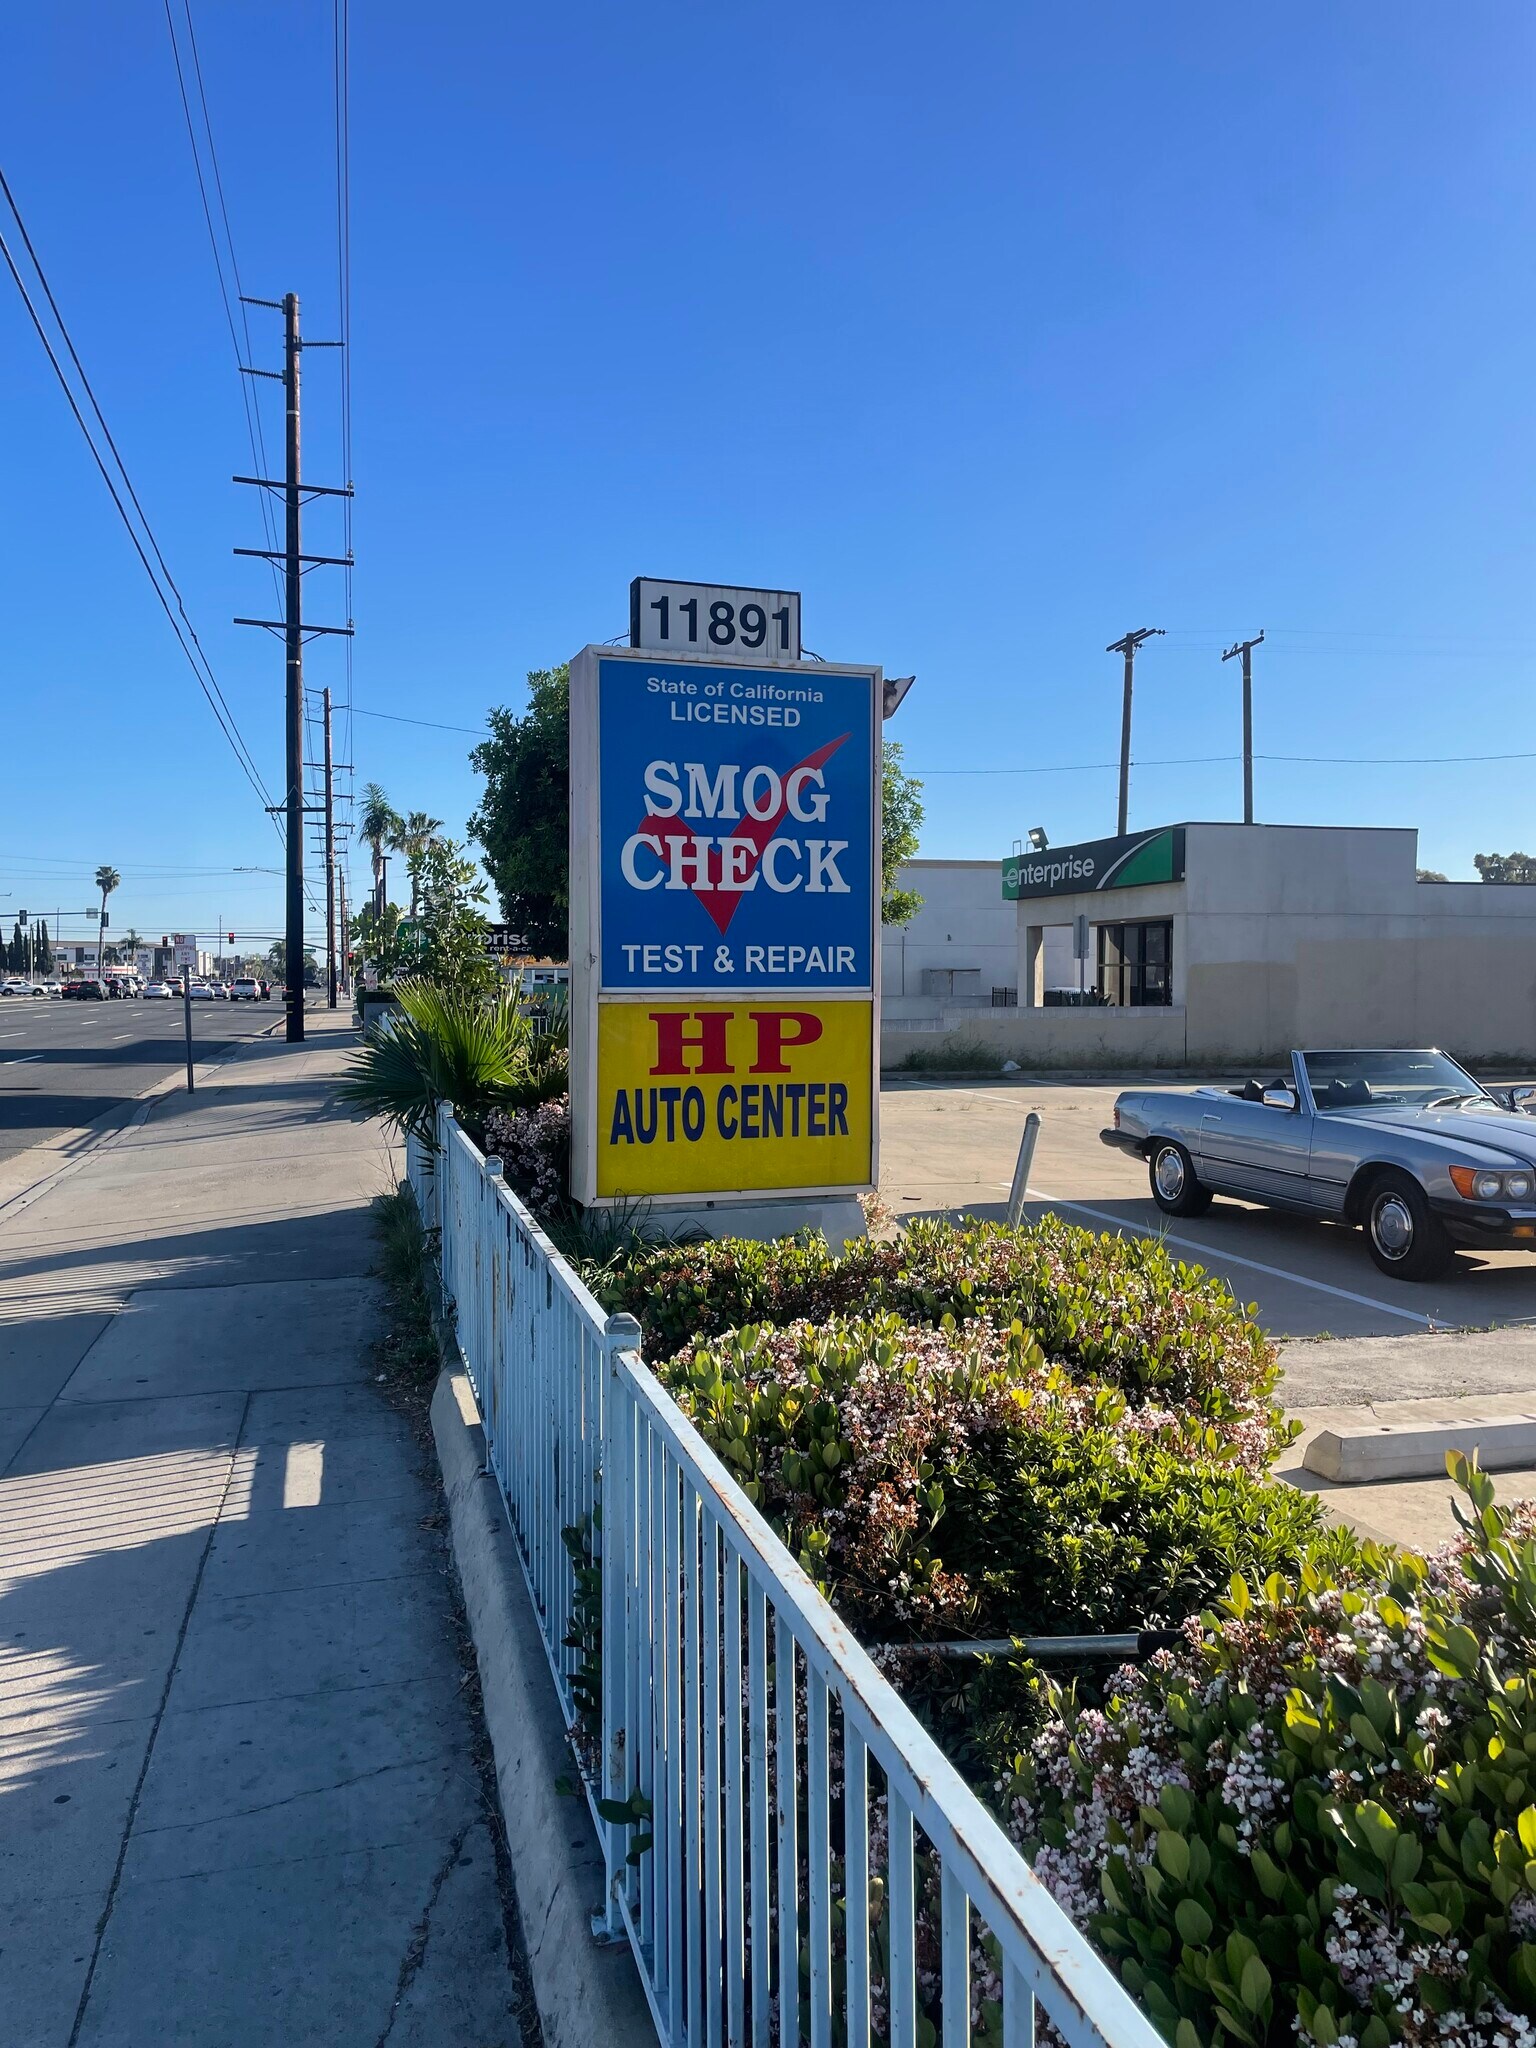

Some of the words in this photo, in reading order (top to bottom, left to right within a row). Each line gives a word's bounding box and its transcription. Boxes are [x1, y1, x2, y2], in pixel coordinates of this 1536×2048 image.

[650, 595, 790, 650] 11891
[646, 676, 698, 695] State
[704, 682, 725, 697] of
[730, 682, 824, 703] California
[670, 700, 801, 727] LICENSED
[643, 759, 831, 822] SMOG
[621, 833, 851, 893] CHECK
[1002, 854, 1095, 888] enterprise
[175, 936, 184, 944] NO
[621, 944, 704, 973] TEST
[713, 945, 735, 973] &
[745, 945, 857, 973] REPAIR
[648, 1012, 824, 1076] HP
[609, 1085, 706, 1145] AUTO
[717, 1083, 849, 1140] CENTER
